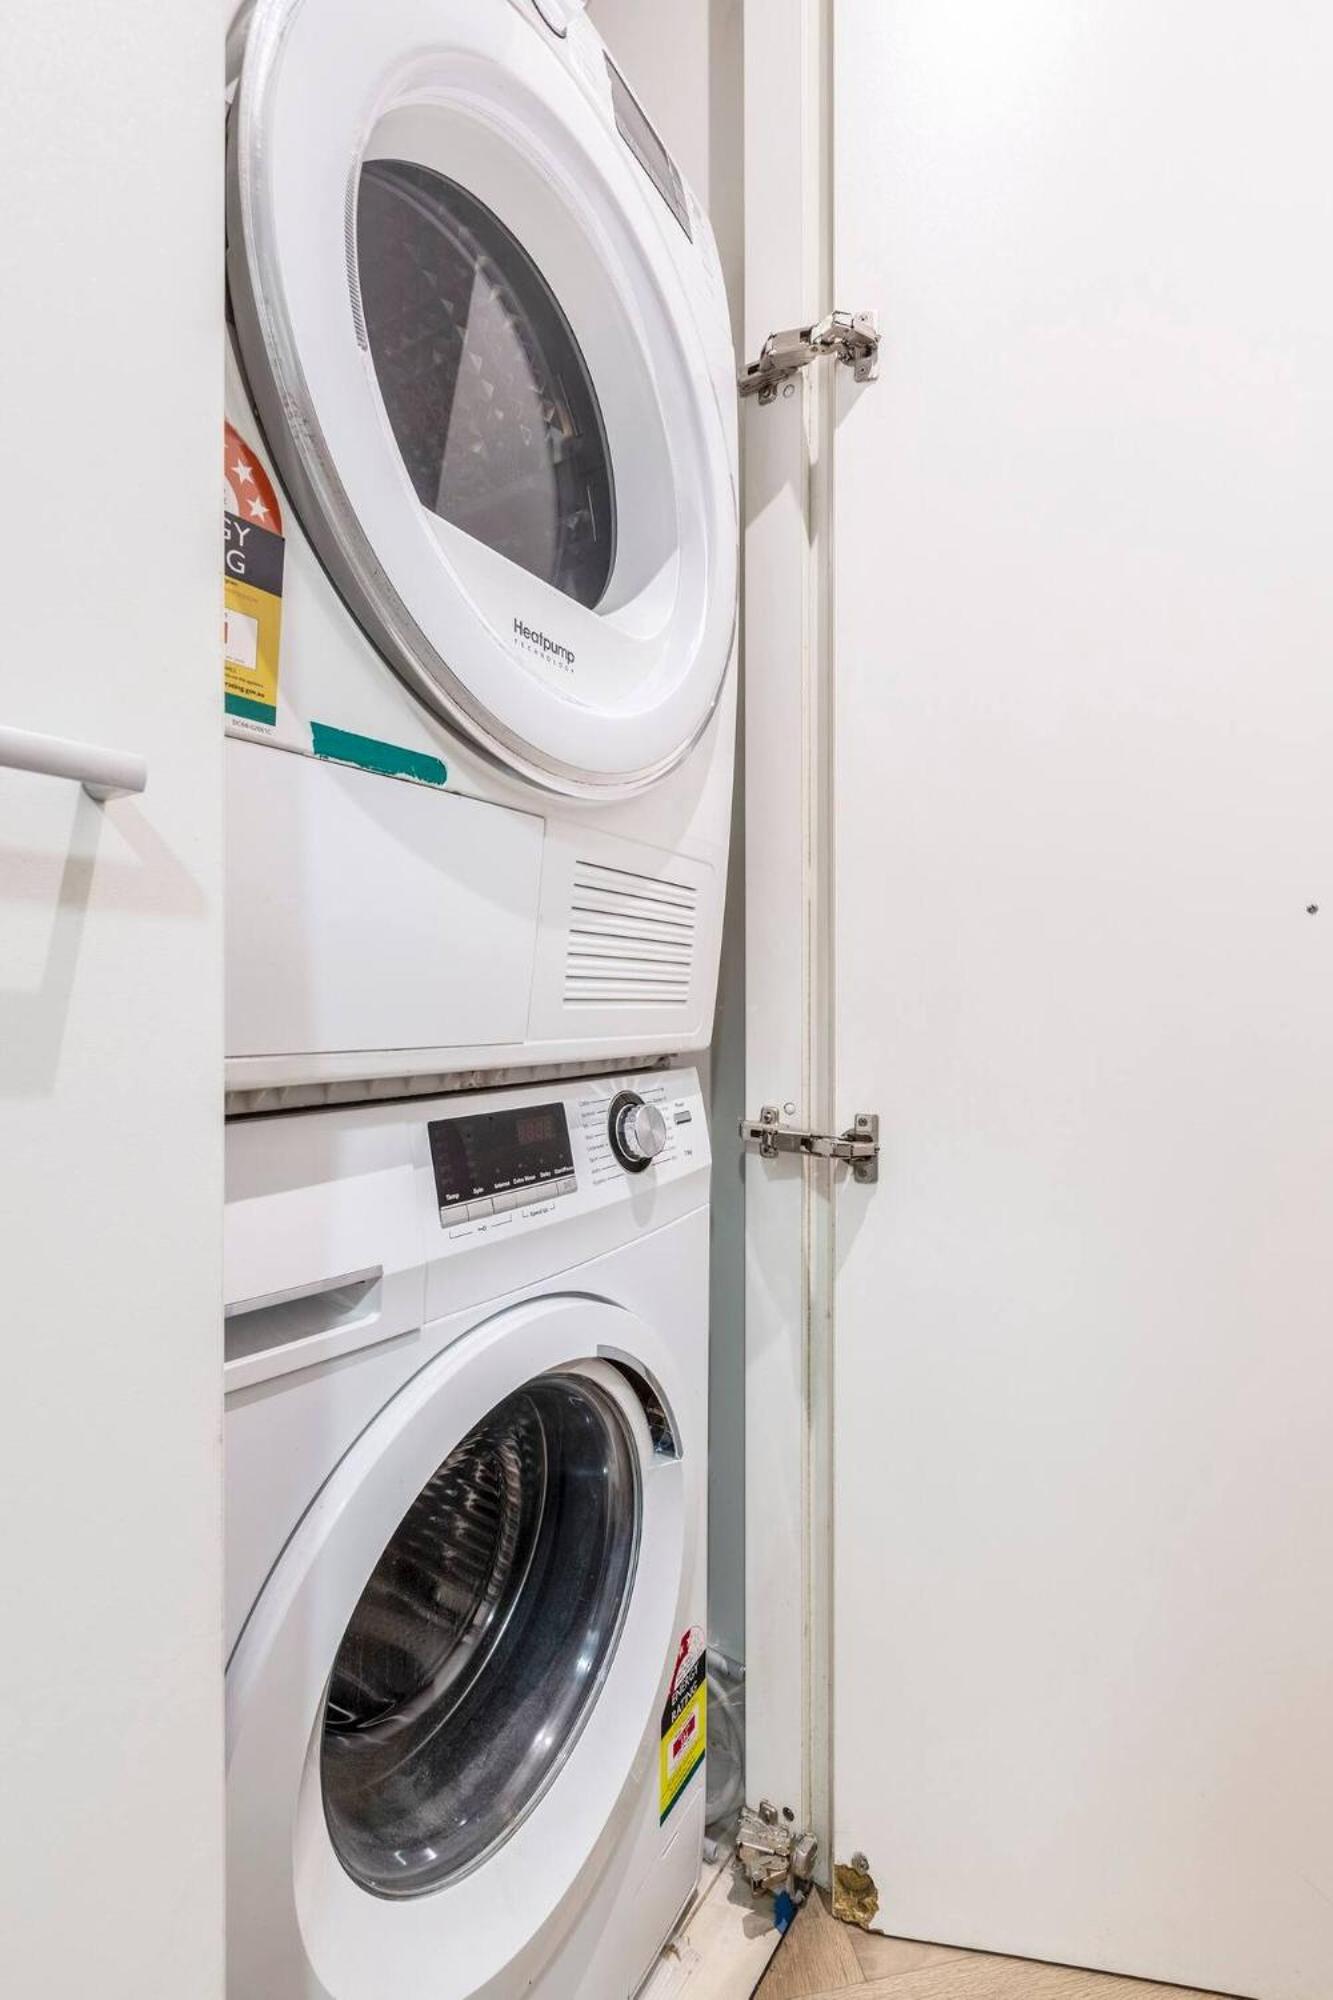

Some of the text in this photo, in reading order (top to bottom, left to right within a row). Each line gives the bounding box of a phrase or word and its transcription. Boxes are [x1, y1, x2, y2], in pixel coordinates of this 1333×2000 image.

[513, 617, 576, 665] Heatpump
[671, 1663, 699, 1706] ENERGY
[671, 1680, 699, 1723] RATING
